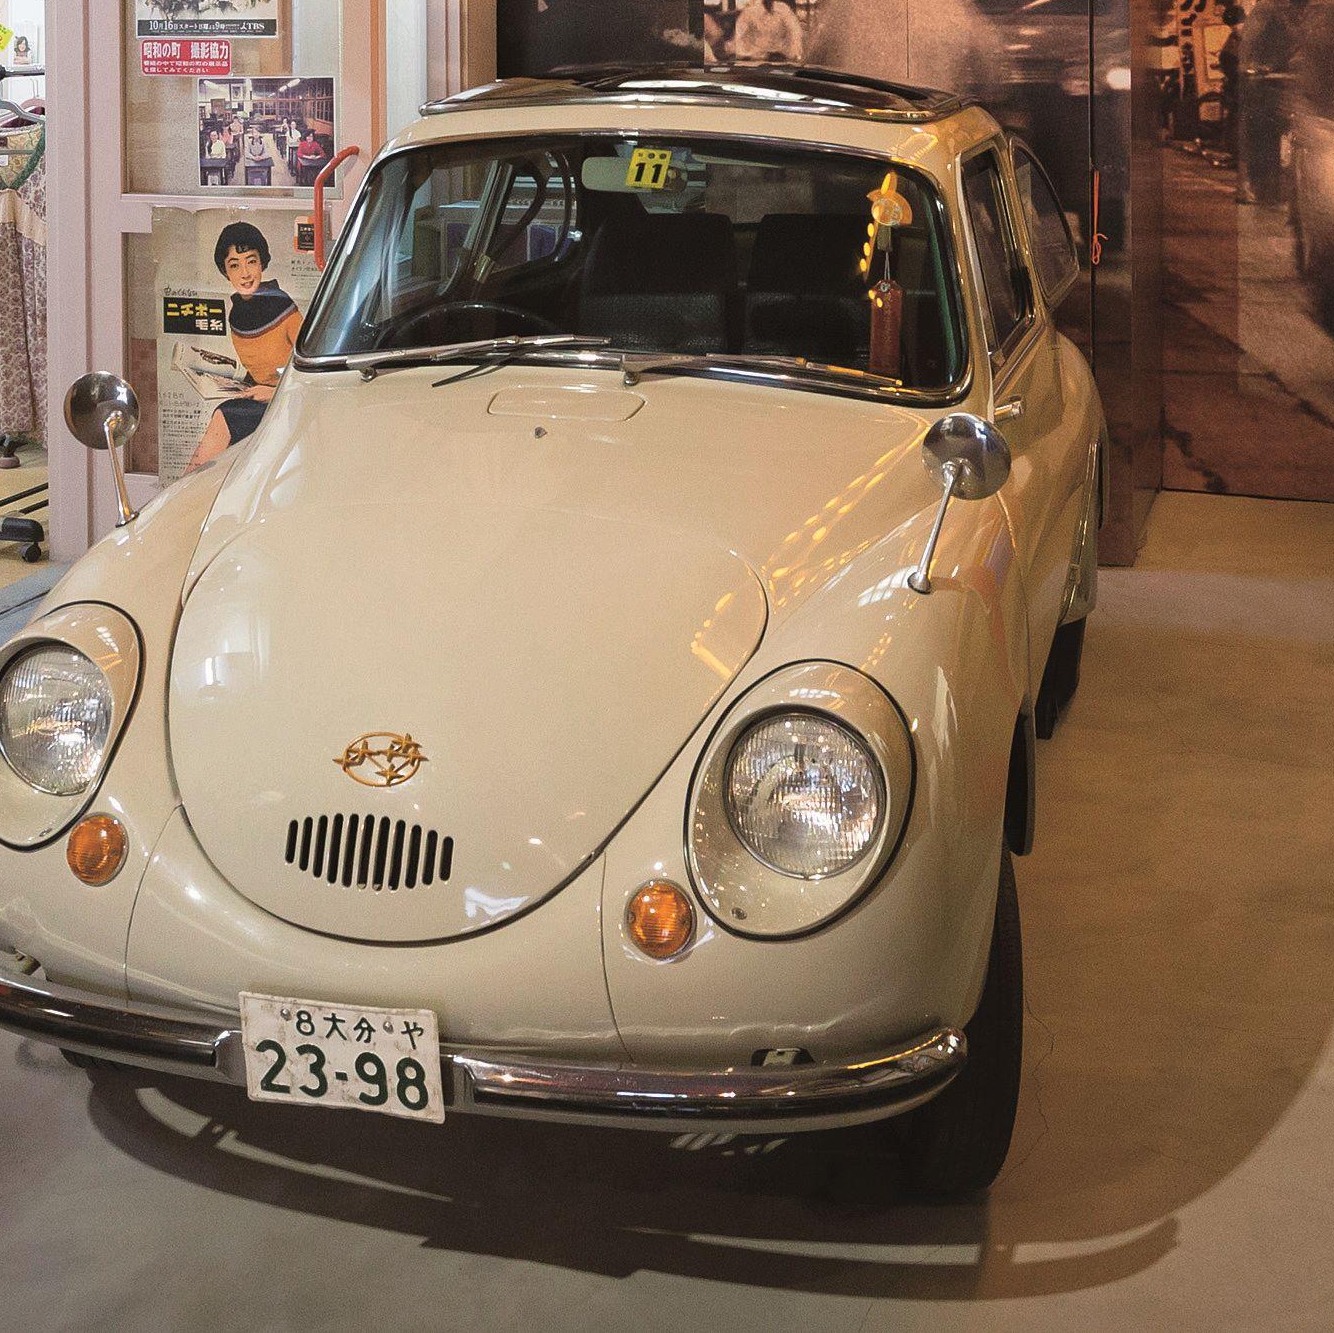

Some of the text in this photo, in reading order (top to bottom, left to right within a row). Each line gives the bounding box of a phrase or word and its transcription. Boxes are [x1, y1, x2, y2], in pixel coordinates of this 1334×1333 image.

[143, 41, 229, 59] 昭和の町 撮影協力
[634, 162, 663, 184] 11
[167, 302, 223, 317] ニチボー
[195, 318, 224, 332] 毛糸
[400, 1020, 425, 1051] や
[255, 1039, 429, 1111] 23-98
